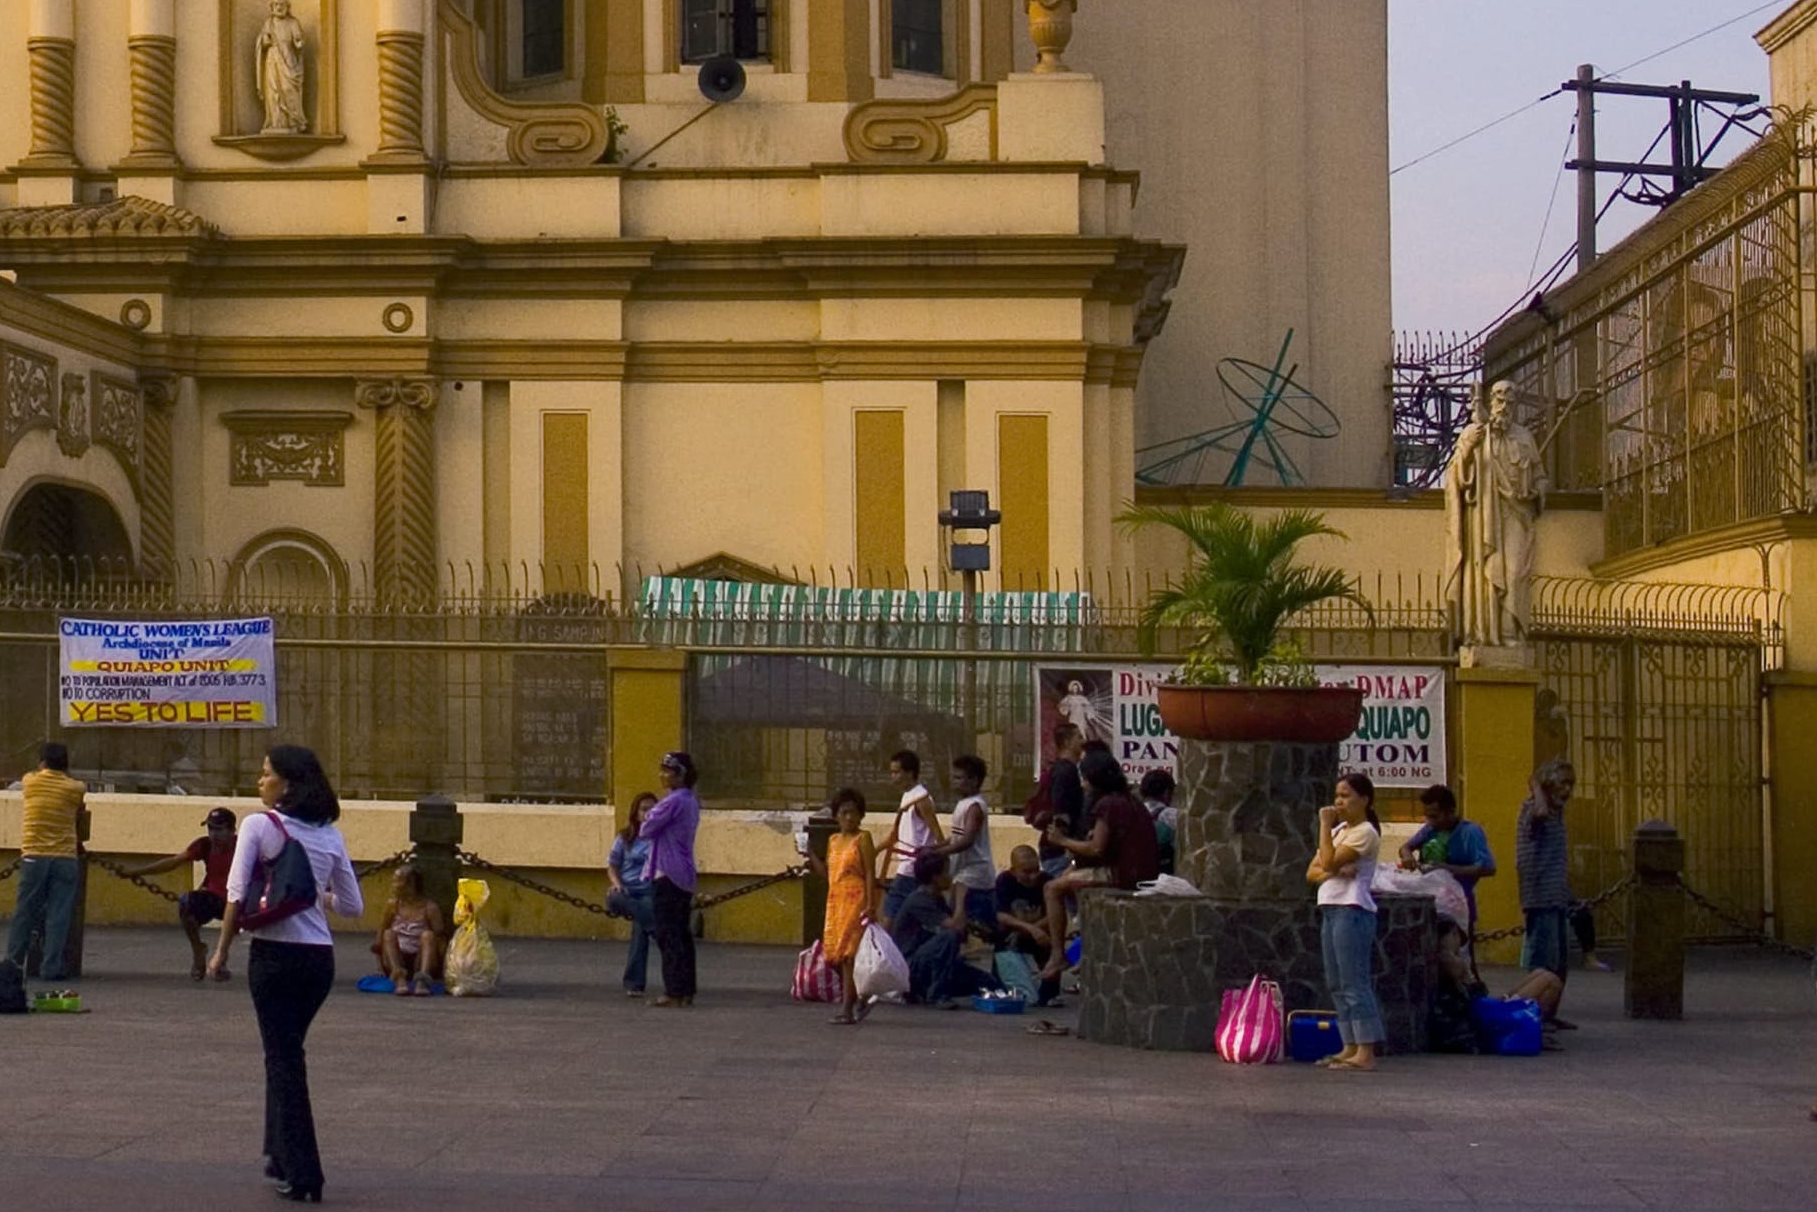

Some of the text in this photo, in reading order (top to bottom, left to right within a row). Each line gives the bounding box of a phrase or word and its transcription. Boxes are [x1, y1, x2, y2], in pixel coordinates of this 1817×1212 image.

[60, 621, 139, 637] CATHOLIC
[212, 619, 270, 636] LEAGUE
[177, 637, 189, 648] of
[191, 637, 231, 648] Manila
[139, 648, 185, 660] UNIT
[96, 660, 229, 673] QUIAPO UNIT
[85, 688, 150, 700] CORRUPTION
[70, 701, 253, 723] YES TO LIFE
[1356, 706, 1430, 741] QUIAPO
[1123, 741, 1179, 760] PAN
[1377, 766, 1407, 778] 6:00
[1410, 766, 1431, 778] NG
